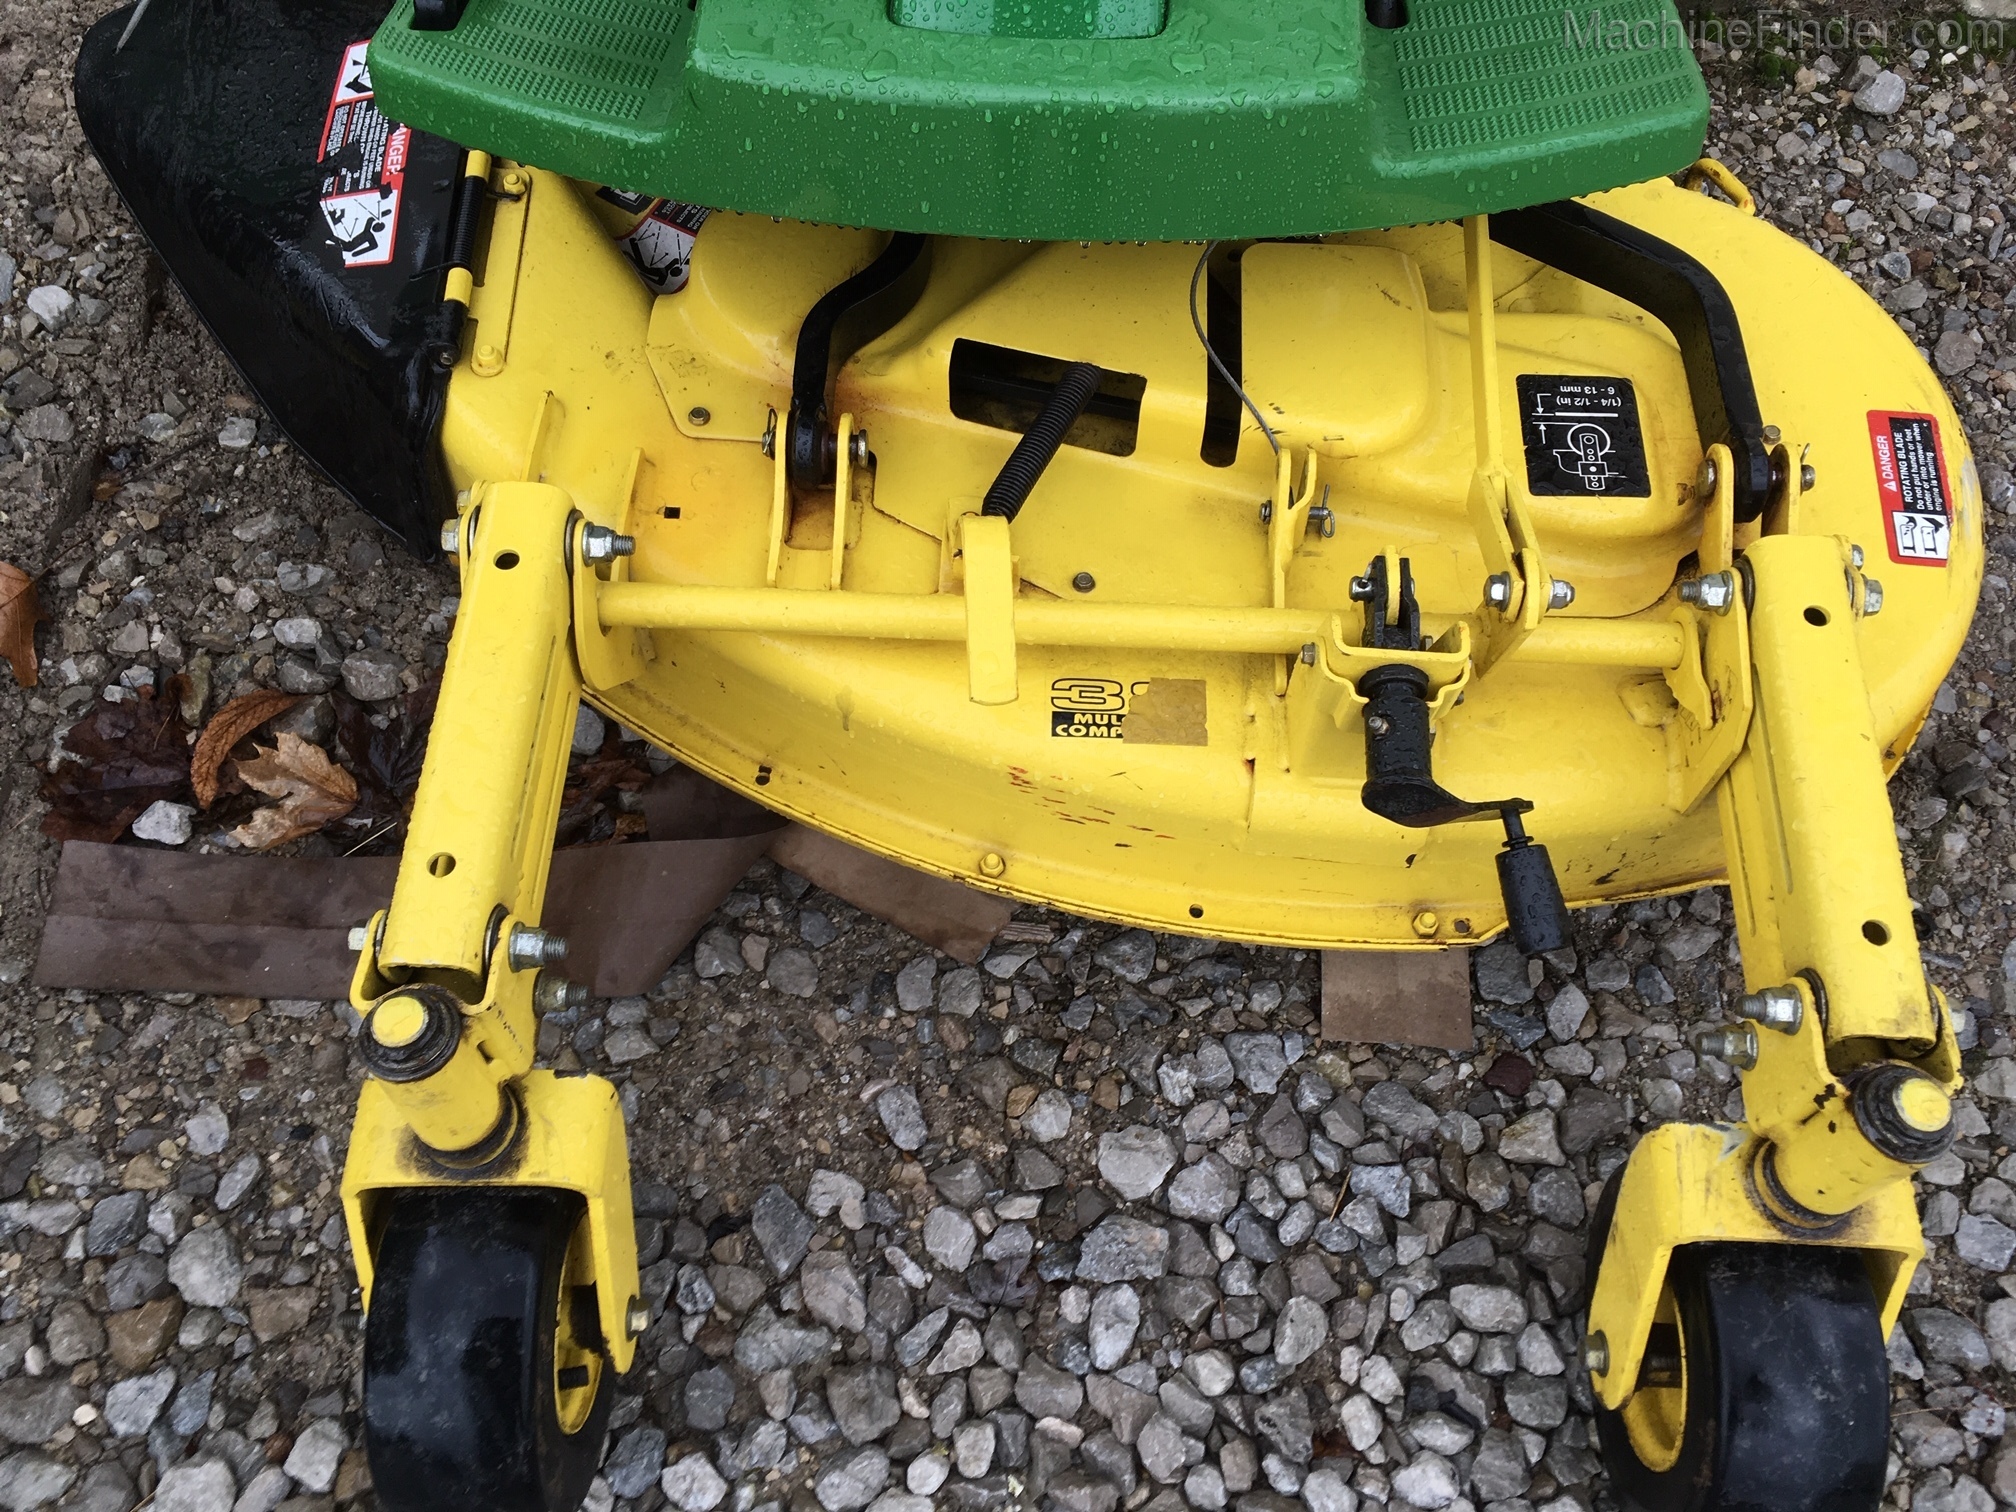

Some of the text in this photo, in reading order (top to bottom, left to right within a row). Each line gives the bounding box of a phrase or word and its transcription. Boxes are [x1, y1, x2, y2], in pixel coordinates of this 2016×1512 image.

[1904, 429, 1913, 442] feet
[1913, 423, 1921, 441] when
[1877, 436, 1894, 479] DANGER
[1909, 451, 1918, 472] hands
[1916, 442, 1925, 464] mower
[1894, 432, 1913, 502] ROTATING BLADE
[1926, 452, 1936, 478] running
[1912, 474, 1922, 485] put
[1917, 500, 1924, 510] Do
[1924, 490, 1933, 510] under
[1933, 488, 1942, 511] engine
[1051, 678, 1151, 712] 3
[1074, 714, 1126, 725] MUL
